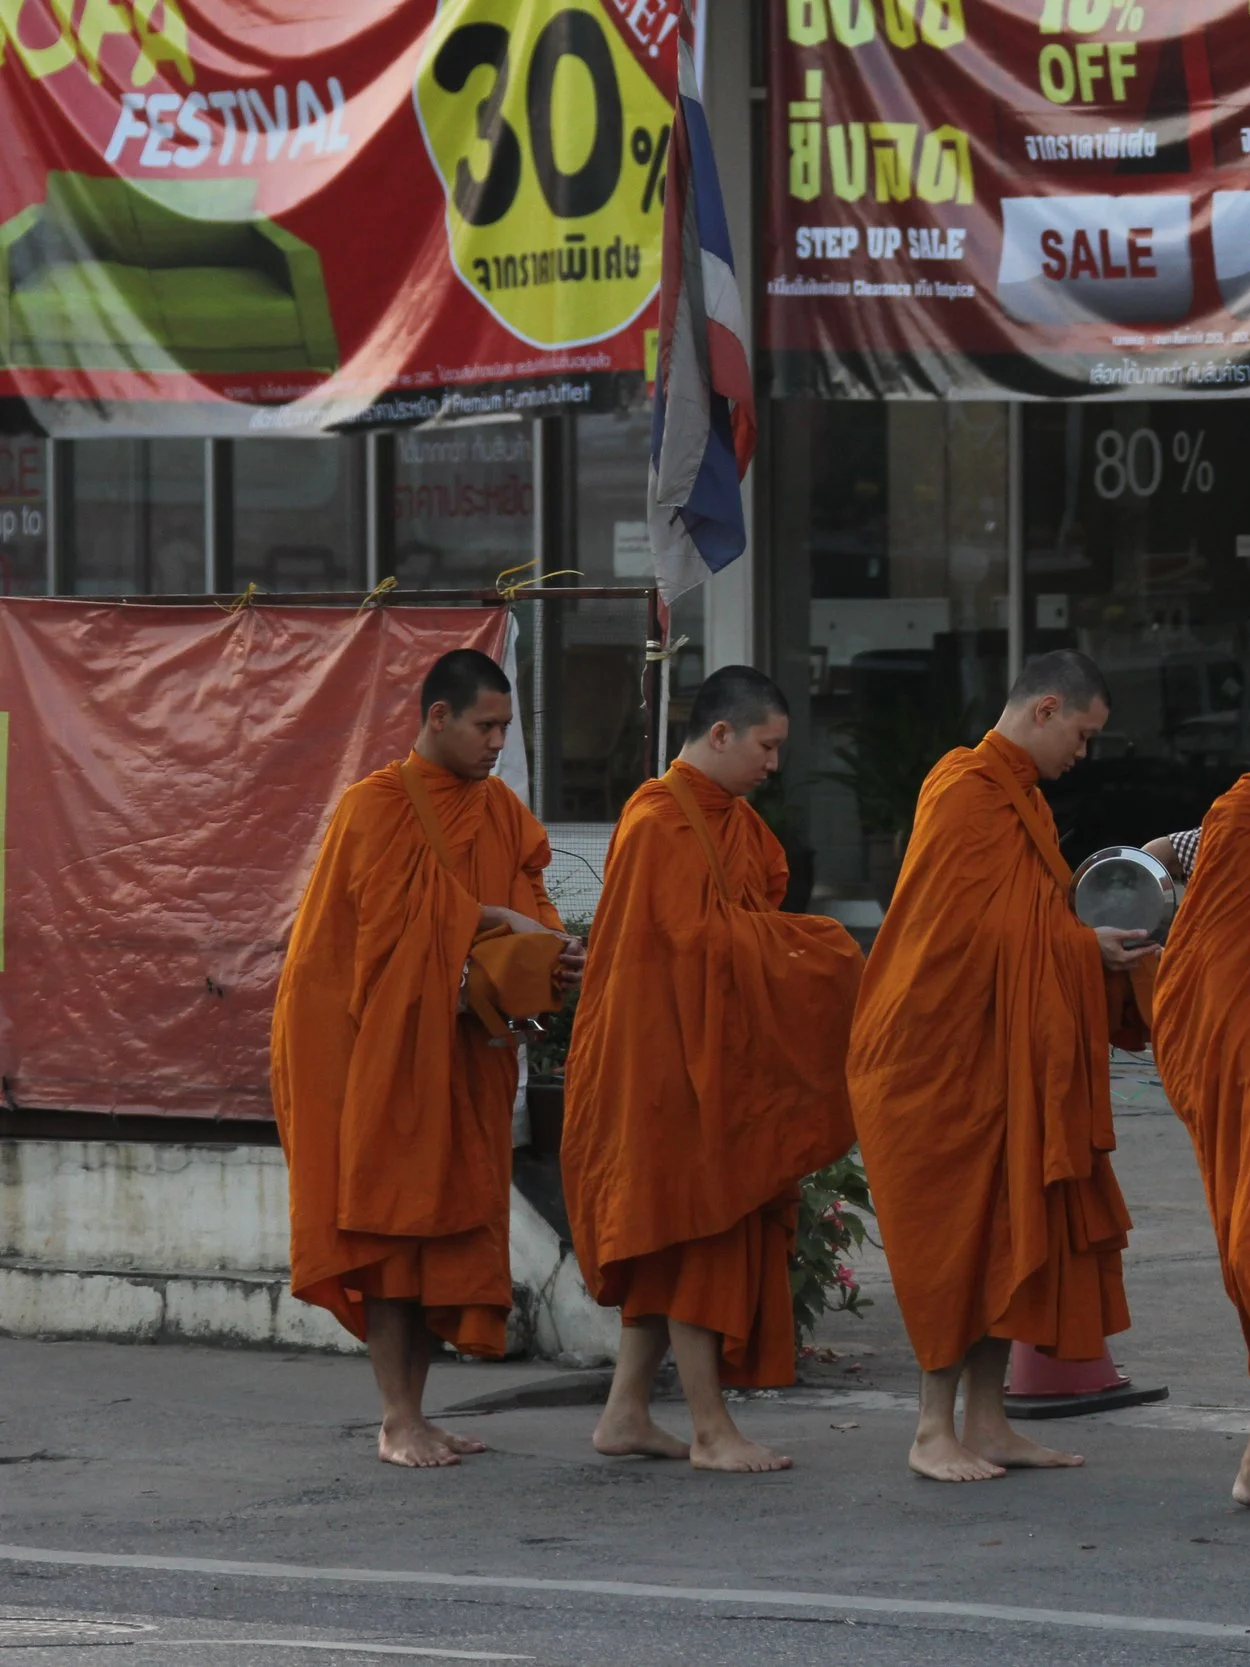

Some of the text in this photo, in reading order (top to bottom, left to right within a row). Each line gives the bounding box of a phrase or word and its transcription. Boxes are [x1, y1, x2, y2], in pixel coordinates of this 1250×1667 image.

[0, 0, 196, 87] OFA
[1039, 41, 1137, 104] OFF
[104, 77, 350, 168] FESTIVAL
[433, 8, 673, 226] 30%
[787, 69, 975, 204] ยิ่งลด
[1025, 126, 1158, 162] จากราคาพิเศษ
[472, 234, 642, 292] จากราคาพิเศษ
[796, 226, 967, 260] STEP UP SALE
[1040, 227, 1158, 281] SALE
[1094, 427, 1216, 500] 80%
[22, 505, 42, 536] to
